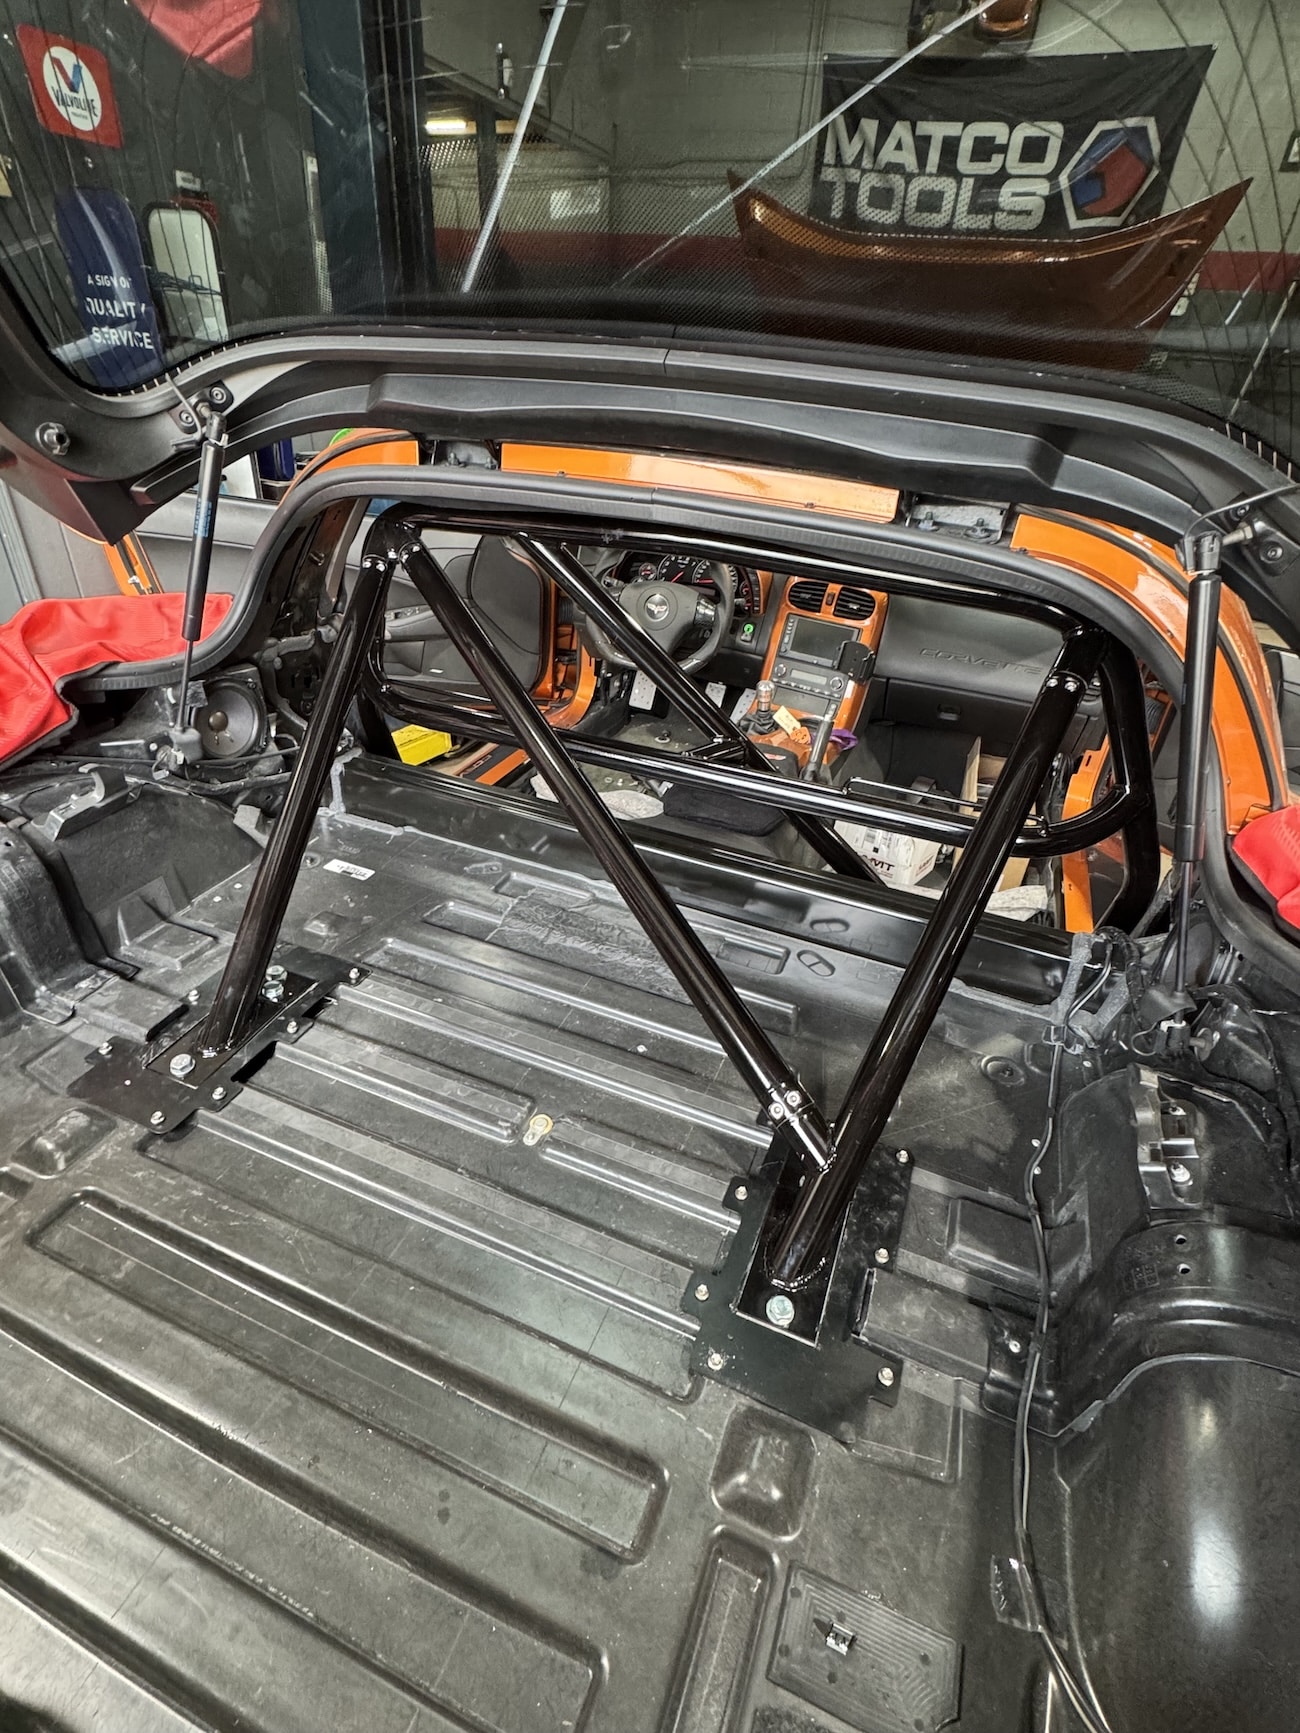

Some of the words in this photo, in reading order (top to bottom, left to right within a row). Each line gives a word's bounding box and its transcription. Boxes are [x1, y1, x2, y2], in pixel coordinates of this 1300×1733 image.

[823, 114, 1065, 176] MATCO
[819, 166, 1051, 231] TOOLS
[87, 274, 94, 285] A
[91, 325, 154, 350] SERVICE
